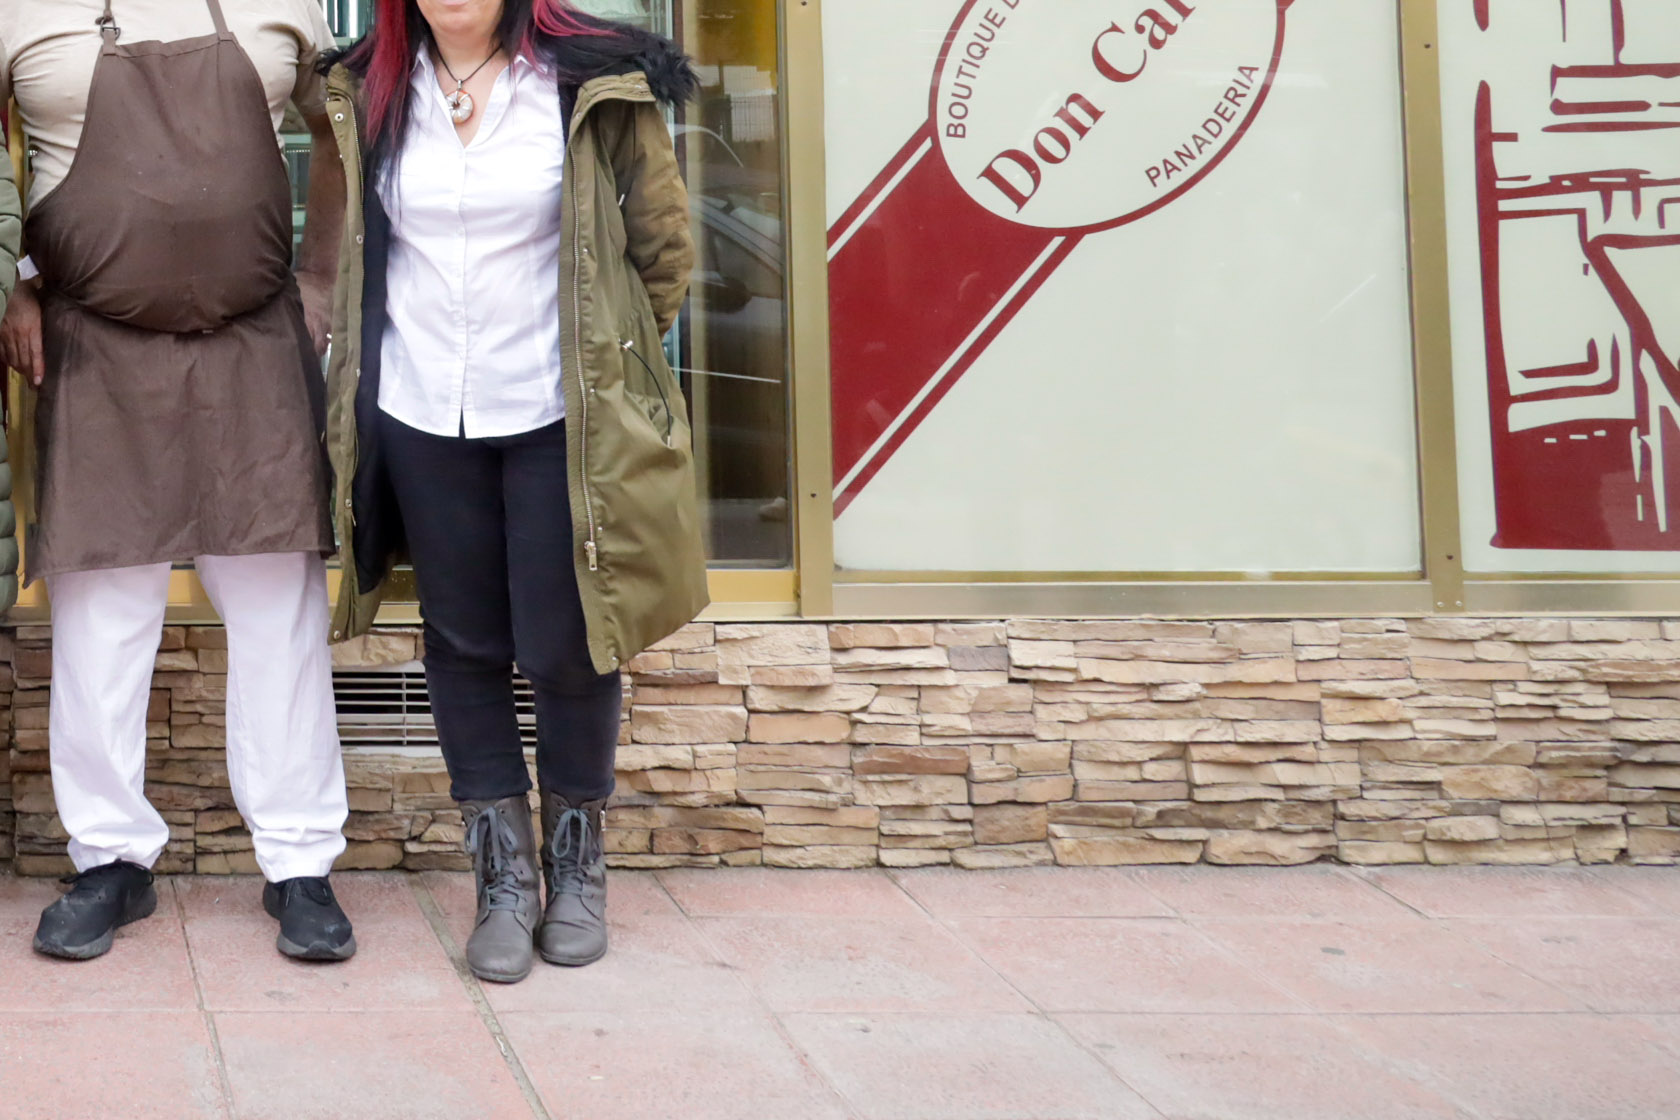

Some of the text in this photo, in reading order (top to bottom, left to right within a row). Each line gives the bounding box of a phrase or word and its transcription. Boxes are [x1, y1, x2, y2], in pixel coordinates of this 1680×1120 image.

[946, 6, 1007, 139] BOUTIQUE
[1144, 63, 1259, 187] PANADERIA
[976, 91, 1106, 214] Don
